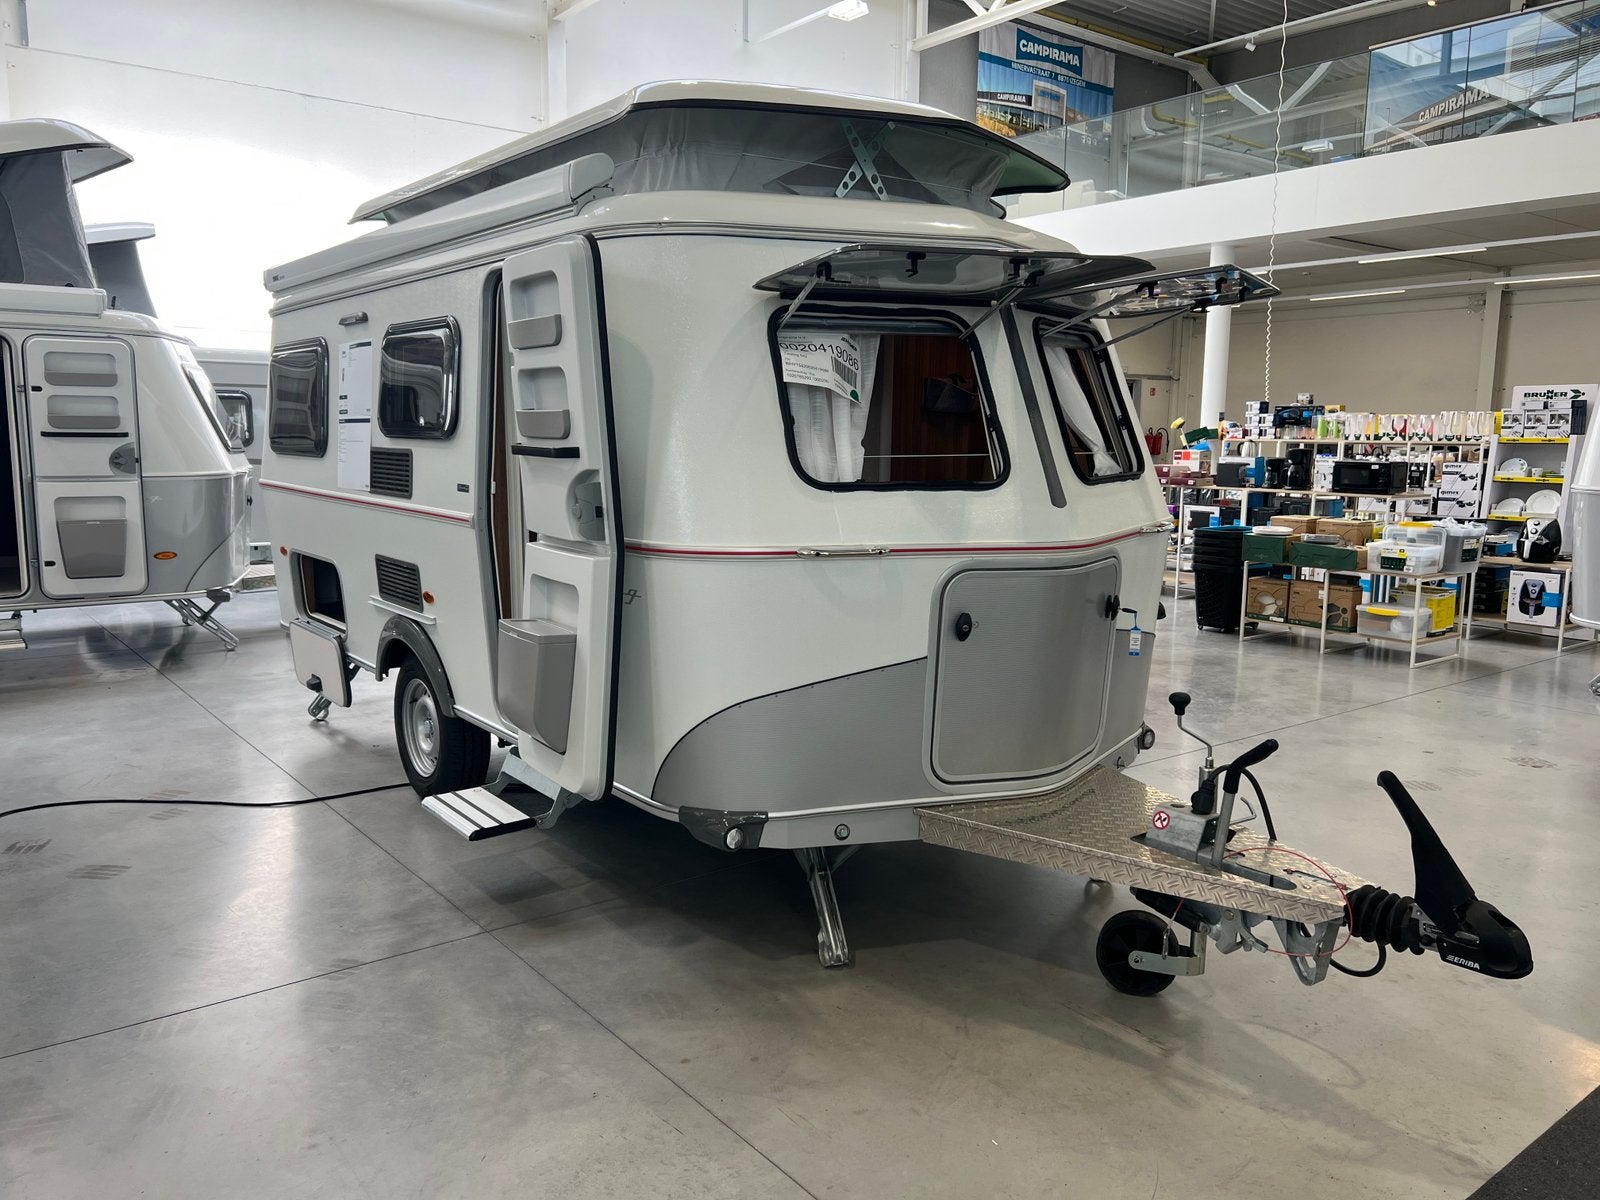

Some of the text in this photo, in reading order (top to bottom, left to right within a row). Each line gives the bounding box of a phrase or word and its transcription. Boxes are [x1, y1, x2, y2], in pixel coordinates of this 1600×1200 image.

[1019, 39, 1080, 67] CAMPIRAMA
[1011, 62, 1051, 78] MINERVASTRAAT
[1069, 76, 1086, 87] IZEGEM
[997, 93, 1026, 103] CAMPIRAMA
[1418, 84, 1490, 123] CAMPIRAMA
[779, 342, 859, 371] 0020419086
[1523, 389, 1568, 400] BRUNNER
[1453, 956, 1480, 970] ERIBA
